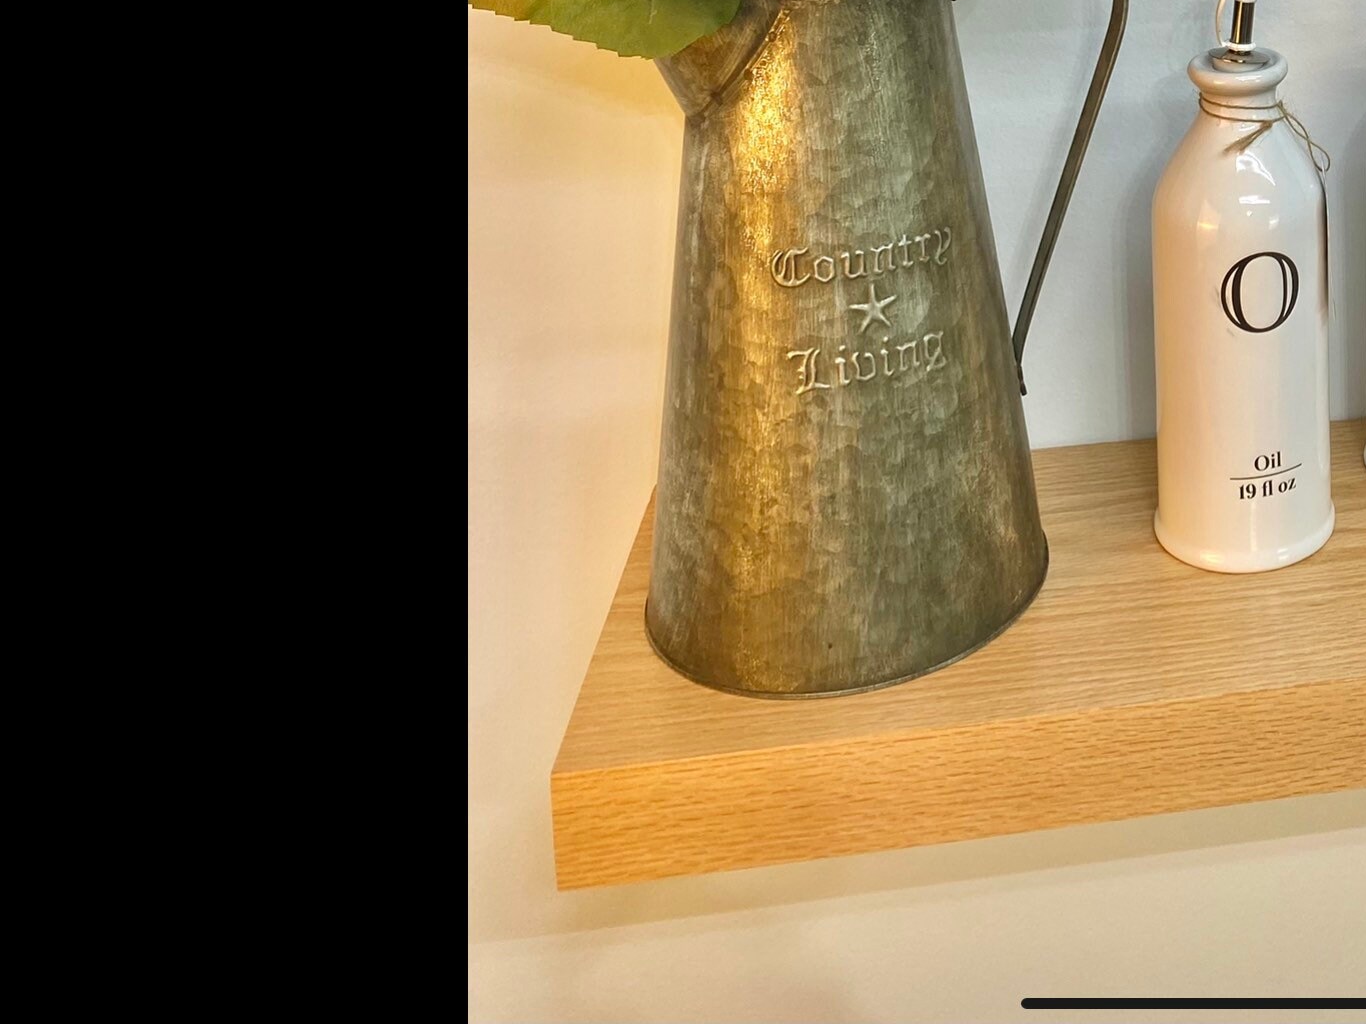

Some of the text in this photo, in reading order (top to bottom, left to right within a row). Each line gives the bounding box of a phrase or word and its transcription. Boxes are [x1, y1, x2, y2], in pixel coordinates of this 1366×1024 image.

[771, 226, 951, 287] Country
[1220, 251, 1299, 333] O
[787, 330, 947, 395] Living
[1238, 477, 1296, 500] 19 fl oz
[1254, 451, 1282, 472] Oil
